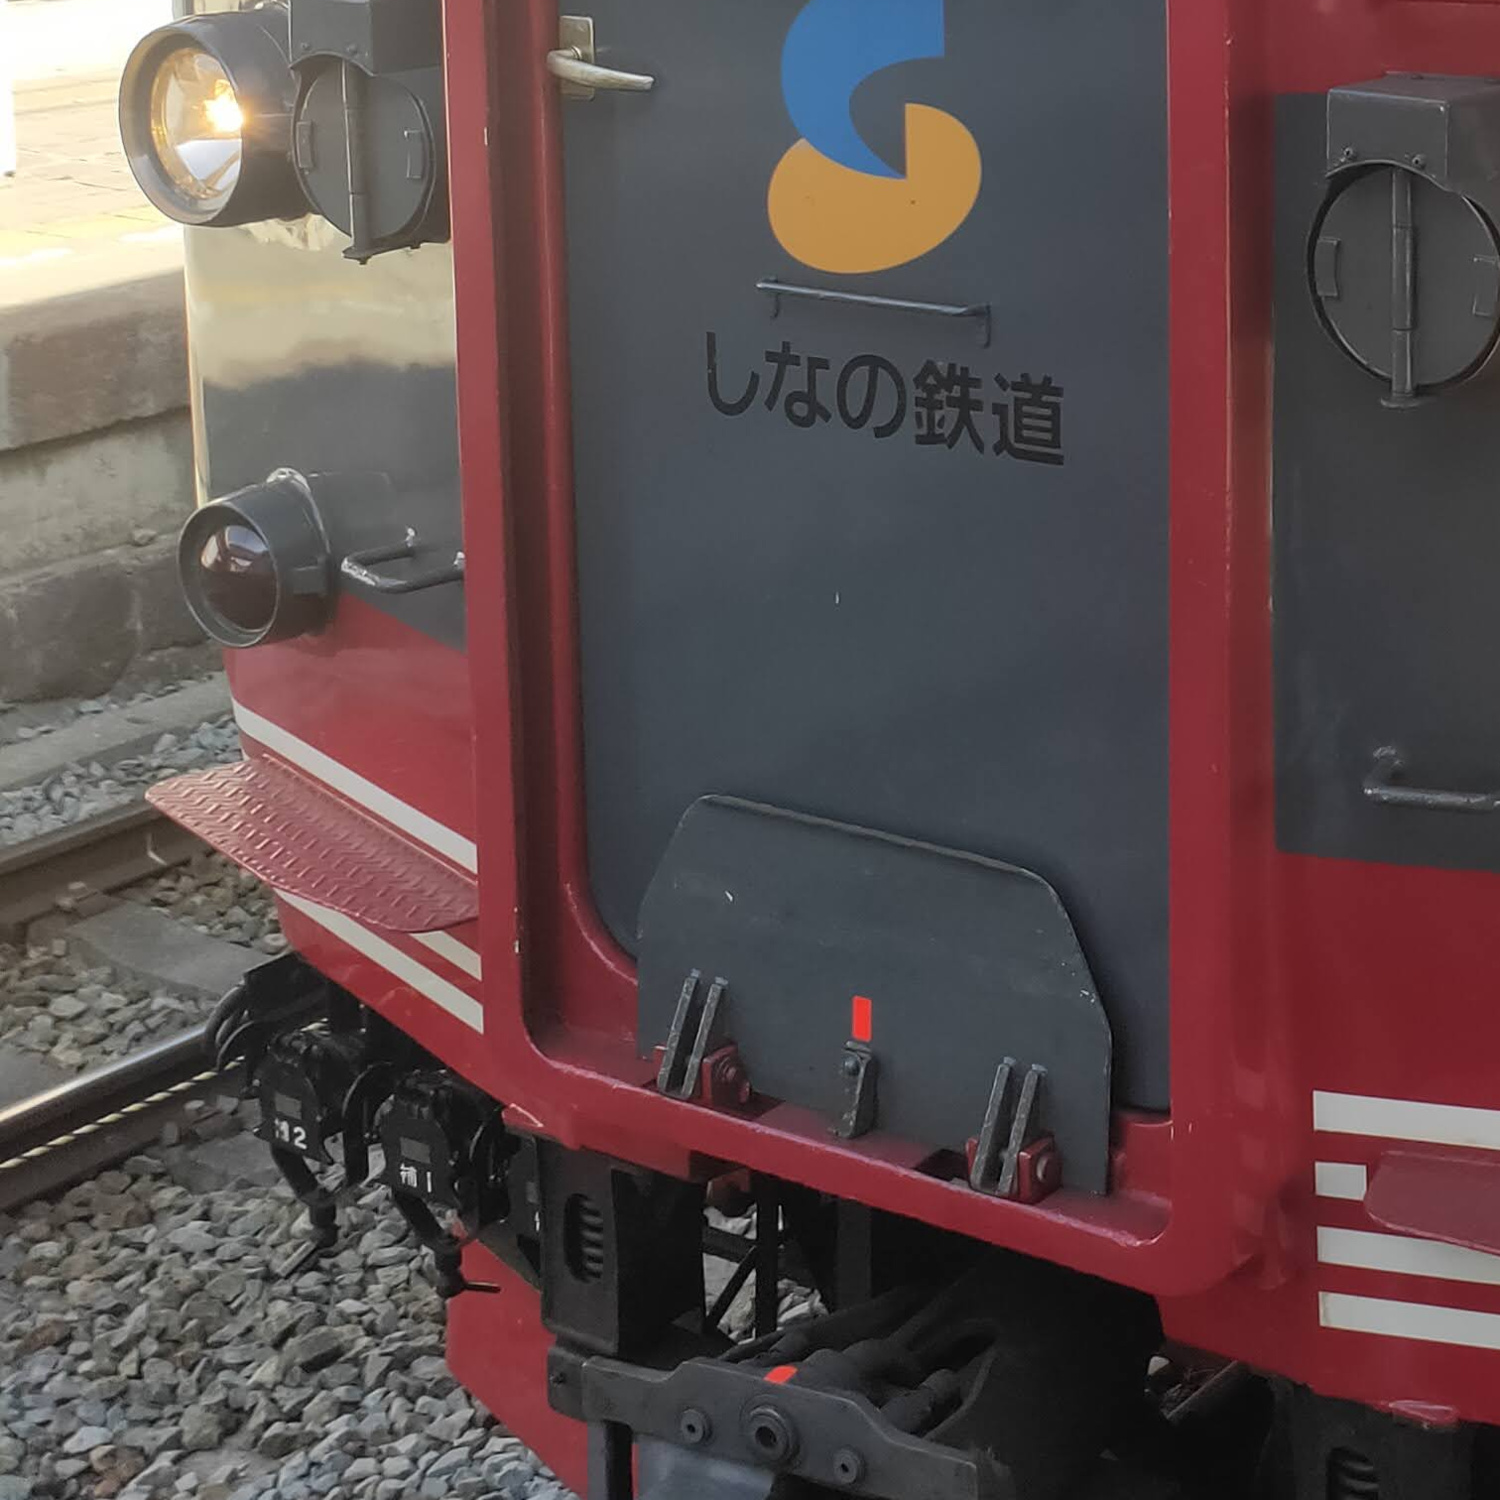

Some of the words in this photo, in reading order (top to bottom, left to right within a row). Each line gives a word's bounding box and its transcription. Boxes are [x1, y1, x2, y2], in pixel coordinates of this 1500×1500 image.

[706, 331, 1064, 466] しなの鉄道
